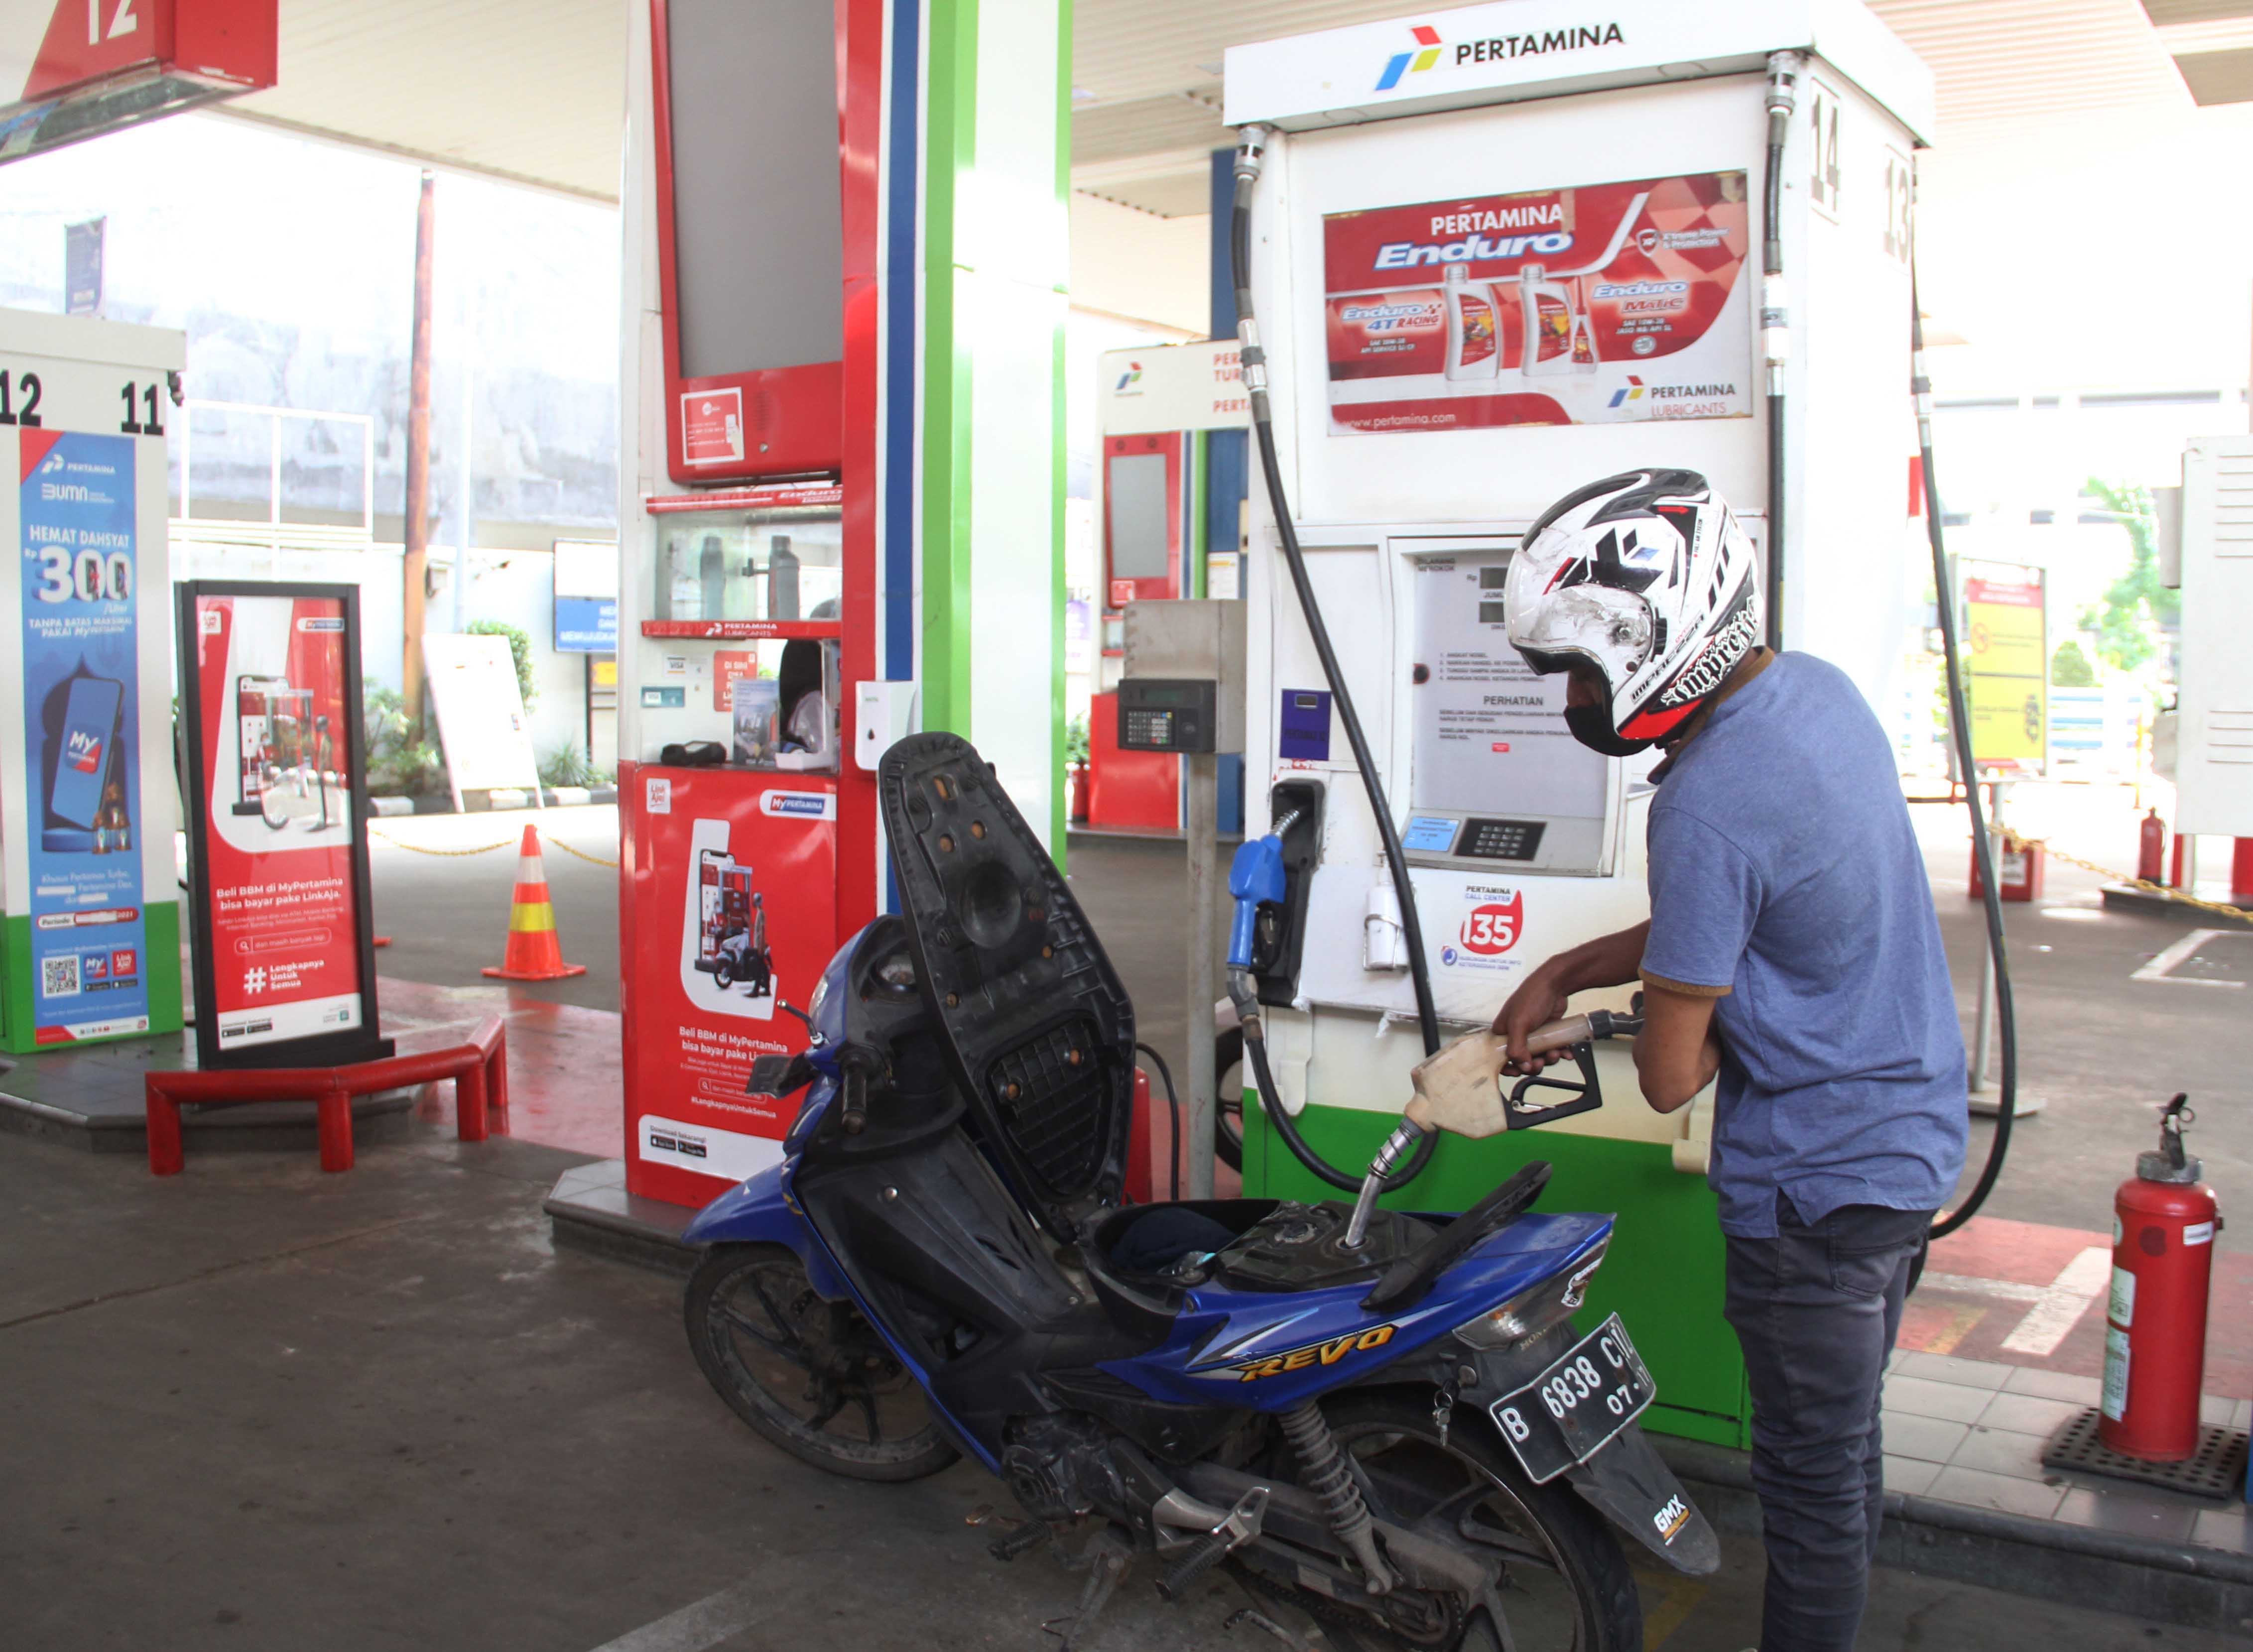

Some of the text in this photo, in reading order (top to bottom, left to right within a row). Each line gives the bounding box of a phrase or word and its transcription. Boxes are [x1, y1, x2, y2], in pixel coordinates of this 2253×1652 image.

[1456, 22, 1625, 65] PERTAMINA
[1811, 94, 1840, 212] 14
[1431, 203, 1563, 236] PERTAMINA
[1884, 158, 1909, 264] 13
[1373, 231, 1574, 271] Enduro
[1593, 281, 1687, 299] Enduro
[1342, 304, 1423, 320] Enduro
[1397, 315, 1439, 328] RACING
[1213, 352, 1241, 365] PER
[1214, 369, 1241, 382] TUR
[1651, 384, 1736, 399] PERTAMINA
[0, 369, 164, 436] 12 11
[1651, 402, 1727, 417] LUBRICANTS
[67, 463, 116, 474] PERTAMINA
[30, 524, 130, 547] HEMAT DAHSYAT
[39, 544, 132, 603] 300
[1483, 696, 1543, 706] PERHATIAN
[216, 877, 344, 898] Beli BBM di MyPertamina
[1466, 885, 1510, 894] PERTAMINA
[220, 898, 242, 911] bisa
[244, 896, 273, 910] bayar
[275, 892, 301, 906] pake
[1462, 912, 1514, 947] 135
[270, 959, 325, 973] Lengkapnya
[270, 971, 299, 981] Untuk
[270, 979, 302, 990] Semua
[679, 1026, 788, 1053] Beli BBM di MyPertamina
[681, 1039, 699, 1051] bisa
[701, 1043, 725, 1057] bayar
[726, 1048, 747, 1060] pake
[1235, 1324, 1397, 1383] REVO
[1499, 1407, 1530, 1442] B
[1541, 1355, 1602, 1419] 6838
[1653, 1493, 1689, 1533] GMX
